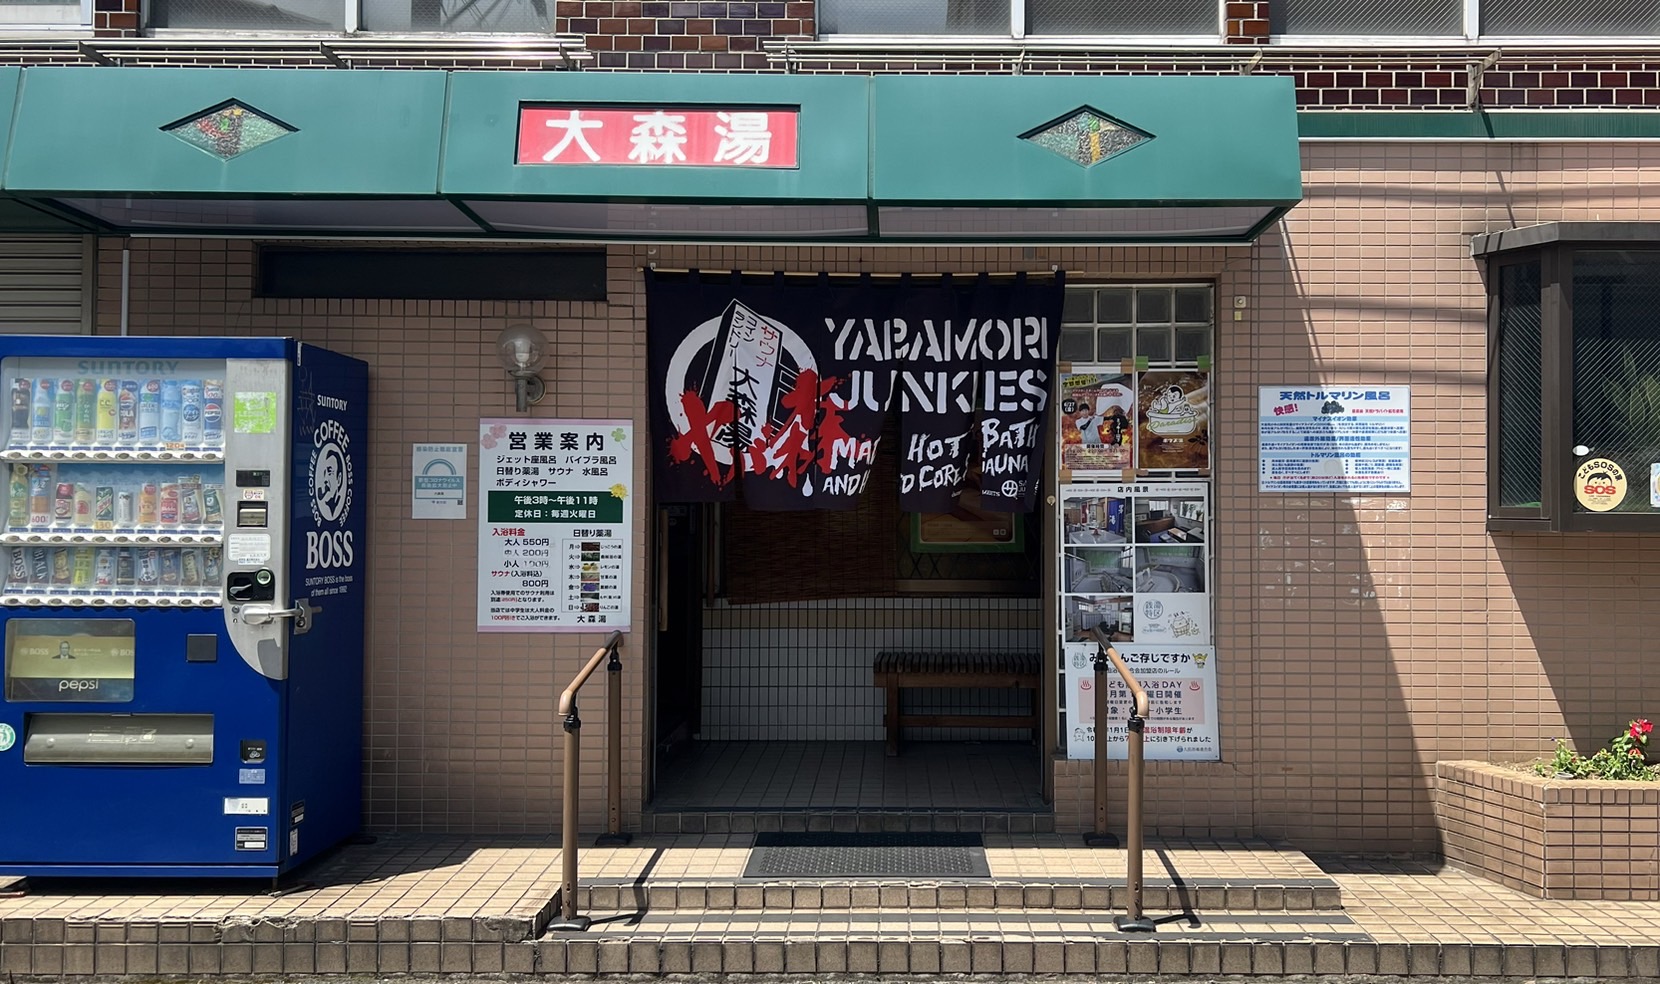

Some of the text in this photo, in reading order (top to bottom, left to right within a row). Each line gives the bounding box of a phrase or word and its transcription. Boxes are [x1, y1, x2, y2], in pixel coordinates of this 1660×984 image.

[542, 110, 772, 165] 大森湯
[742, 315, 758, 343] コイン
[825, 317, 1047, 362] YABAMORI
[757, 325, 779, 368] サウナ
[829, 369, 1047, 414] JUNKIES
[1280, 391, 1390, 400] 天然トルマリン風呂
[317, 394, 348, 411] SUNTORY
[314, 419, 350, 453] COFFEE
[509, 432, 604, 451] 営業案内
[908, 424, 975, 463] HOT
[981, 420, 1041, 454] BATH
[496, 455, 556, 464] ジェット座風呂
[496, 467, 608, 476] 日替り薬湯 サウナ 水風呂
[1578, 461, 1623, 481] こどもSOSの家
[919, 463, 961, 492] CORE
[496, 479, 556, 487] ボディシャワー
[1584, 485, 1617, 494] SOS
[514, 496, 598, 505] 午後3時～午後11時
[514, 509, 596, 519] 定休日：毎週火曜日
[492, 528, 525, 536] 入浴料金
[574, 529, 611, 537] 日替り薬湯
[505, 538, 550, 546] 大人 550円
[306, 531, 353, 569] BOSS
[522, 549, 549, 557] 200円
[13, 549, 26, 579] BOSS
[504, 560, 519, 568] 小人
[522, 579, 549, 587] 800円
[577, 615, 606, 624] 大森湯
[1089, 653, 1190, 663] みんご存じですか
[58, 680, 98, 692] pepsi
[1162, 681, 1182, 689] DAY
